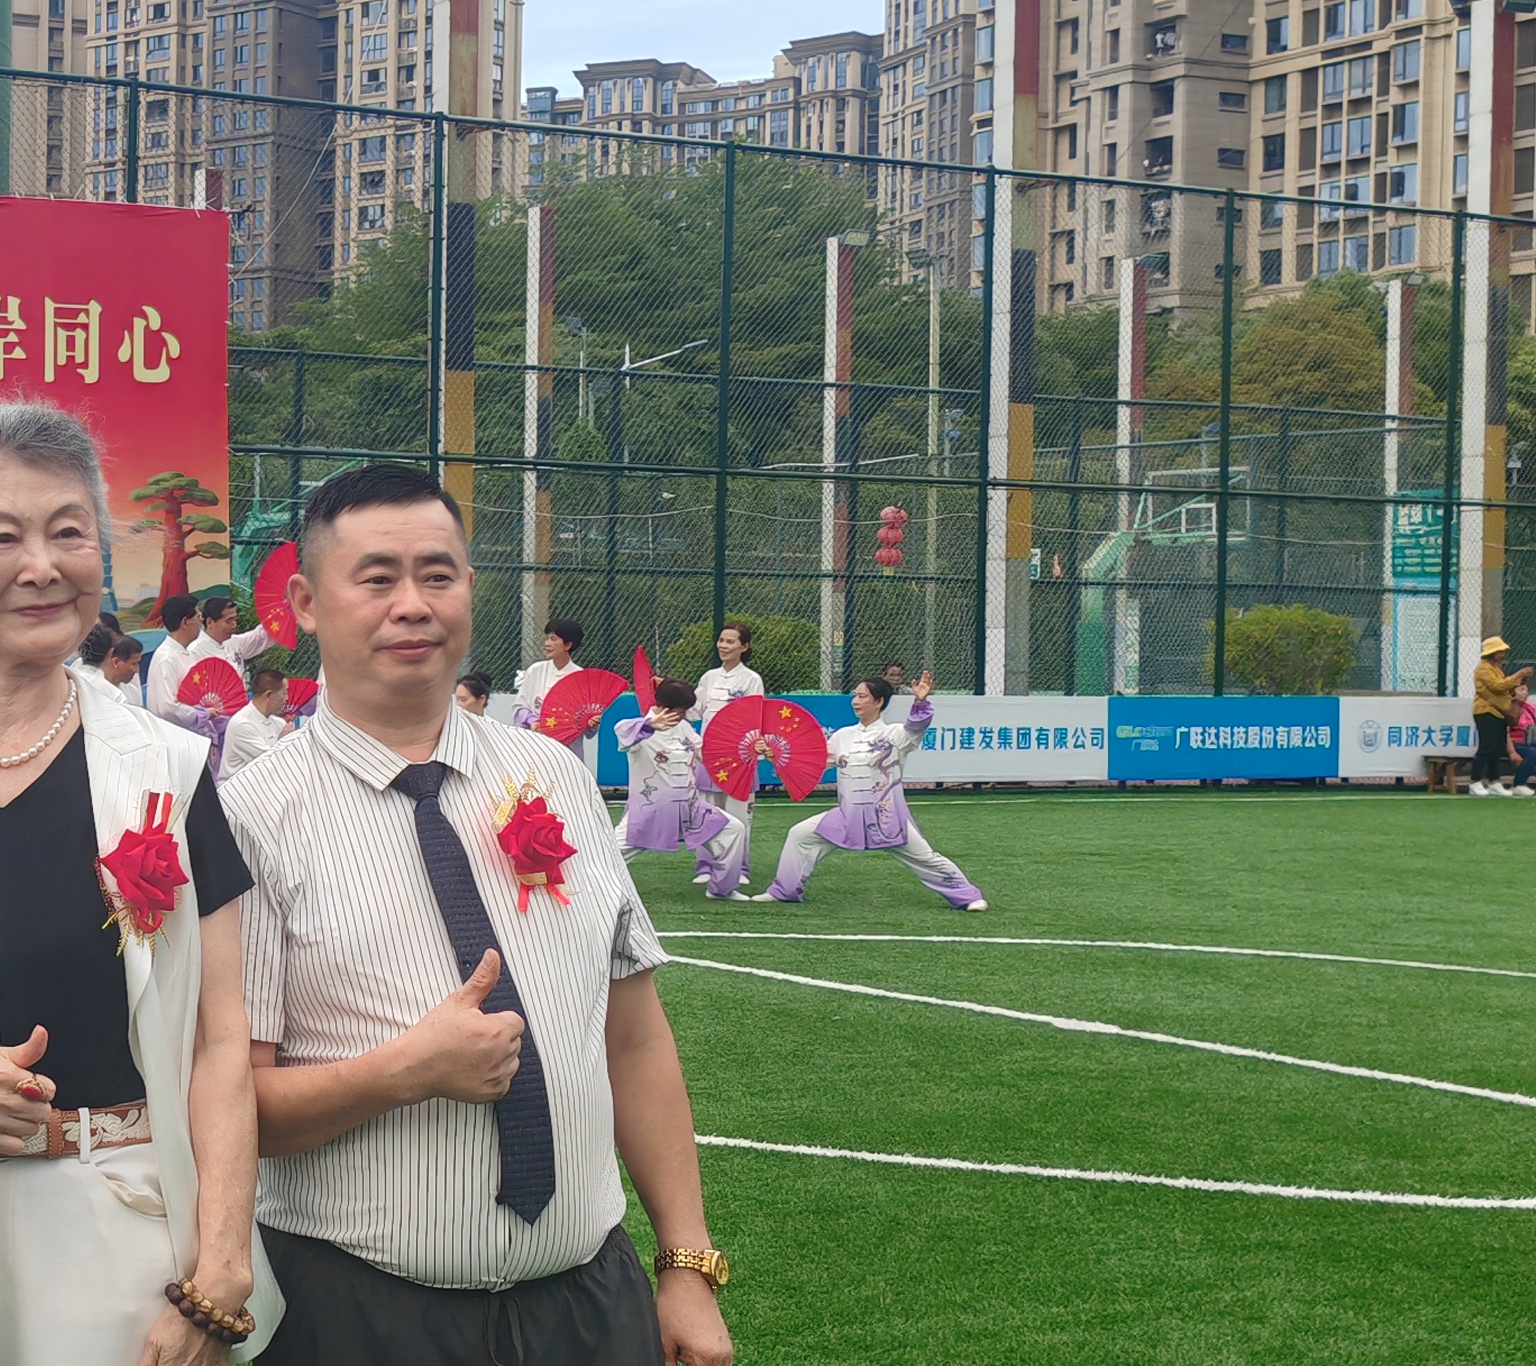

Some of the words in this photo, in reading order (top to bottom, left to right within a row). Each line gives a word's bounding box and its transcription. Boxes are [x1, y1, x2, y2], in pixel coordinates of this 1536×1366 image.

[921, 726, 1105, 751] 厦门建发集团有限公司
[1175, 726, 1332, 749] 广联达科技股份有限公司
